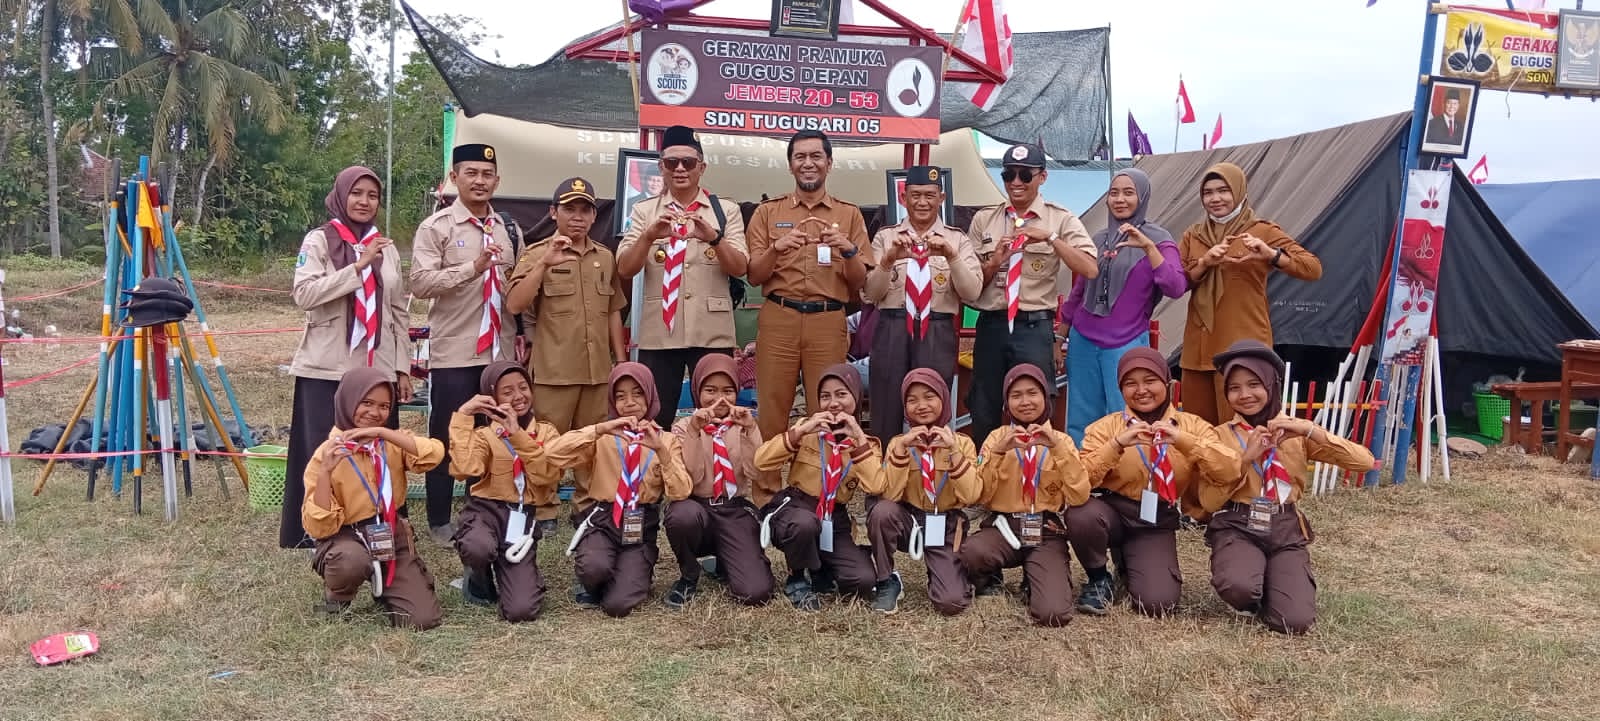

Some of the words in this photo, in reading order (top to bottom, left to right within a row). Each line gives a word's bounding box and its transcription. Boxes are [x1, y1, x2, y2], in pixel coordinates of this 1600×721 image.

[703, 39, 791, 61] GERAKAN
[797, 46, 887, 67] PRAMUKA
[1502, 36, 1558, 53] GERAKA
[1511, 55, 1553, 68] GUGUS
[657, 77, 688, 90] SCOUTS
[720, 61, 795, 83] GUGUS
[800, 67, 869, 86] DEPAN
[724, 83, 802, 104] JEMBER
[804, 88, 833, 107] 20
[849, 91, 879, 109] 53
[704, 110, 746, 128] SDN
[750, 112, 852, 133] TUGUSARI
[857, 118, 880, 133] 05
[577, 151, 616, 165] KE
